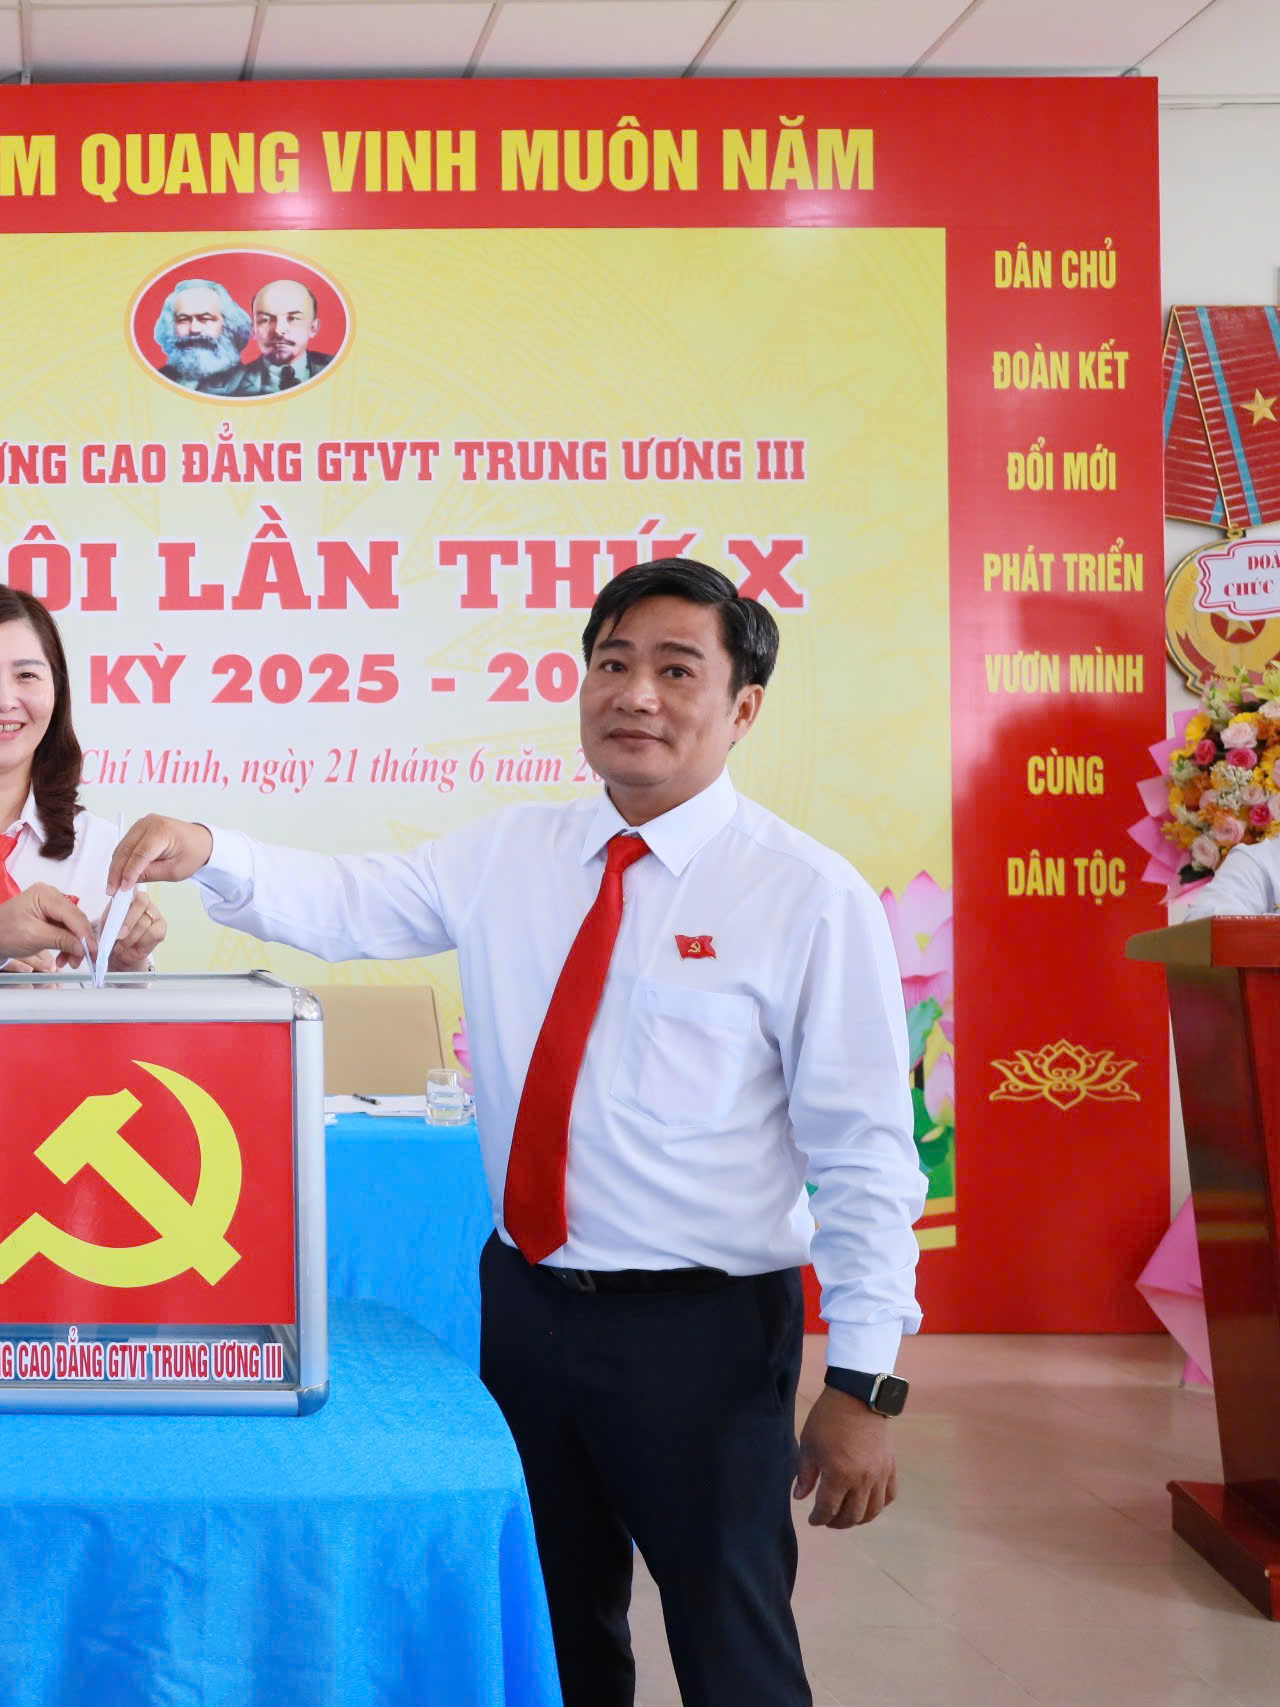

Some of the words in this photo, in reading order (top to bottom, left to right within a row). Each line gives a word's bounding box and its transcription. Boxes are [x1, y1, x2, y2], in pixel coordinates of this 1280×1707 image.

[81, 131, 299, 202] QUANG
[322, 130, 476, 192] VINH
[502, 116, 697, 192] MUÔN
[723, 115, 874, 190] NĂM
[995, 242, 1052, 288] DÂN
[1062, 237, 1116, 288] CHỦ
[994, 344, 1070, 389] ĐOÀN
[1079, 341, 1128, 389] KẾT
[83, 444, 166, 483] CAO
[182, 423, 301, 482] ĐẲNG
[318, 442, 440, 482] GTVT
[455, 441, 607, 480] TRUNG
[622, 438, 741, 480] ƯƠNG
[757, 440, 805, 480] III
[1008, 438, 1053, 491] ĐỔI
[1064, 444, 1116, 491] MỚI
[158, 505, 399, 610] LẦN
[729, 540, 804, 608] X
[984, 546, 1054, 592] PHÁT
[1064, 540, 1143, 592] TRIỂN
[91, 643, 186, 704] KỲ
[213, 654, 399, 704] 2025
[488, 653, 578, 702] 20
[987, 652, 1060, 691] VƯƠN
[1070, 646, 1143, 693] MÌNH
[80, 749, 131, 784] Chí
[138, 749, 228, 790] Minh,
[240, 748, 314, 793] ngày
[324, 748, 358, 783] 21
[370, 748, 457, 793] tháng
[469, 746, 486, 783] 6
[495, 747, 562, 782] năm
[1028, 749, 1103, 794] CÙNG
[1008, 850, 1064, 895] DÂN
[1075, 850, 1125, 904] TỘC
[19, 1345, 50, 1377] CAO
[56, 1328, 103, 1377] ĐẲNG
[109, 1345, 147, 1377] GTVT
[152, 1345, 208, 1377] TRUNG
[214, 1343, 259, 1378] ƯƠNG
[266, 1346, 282, 1377] III
